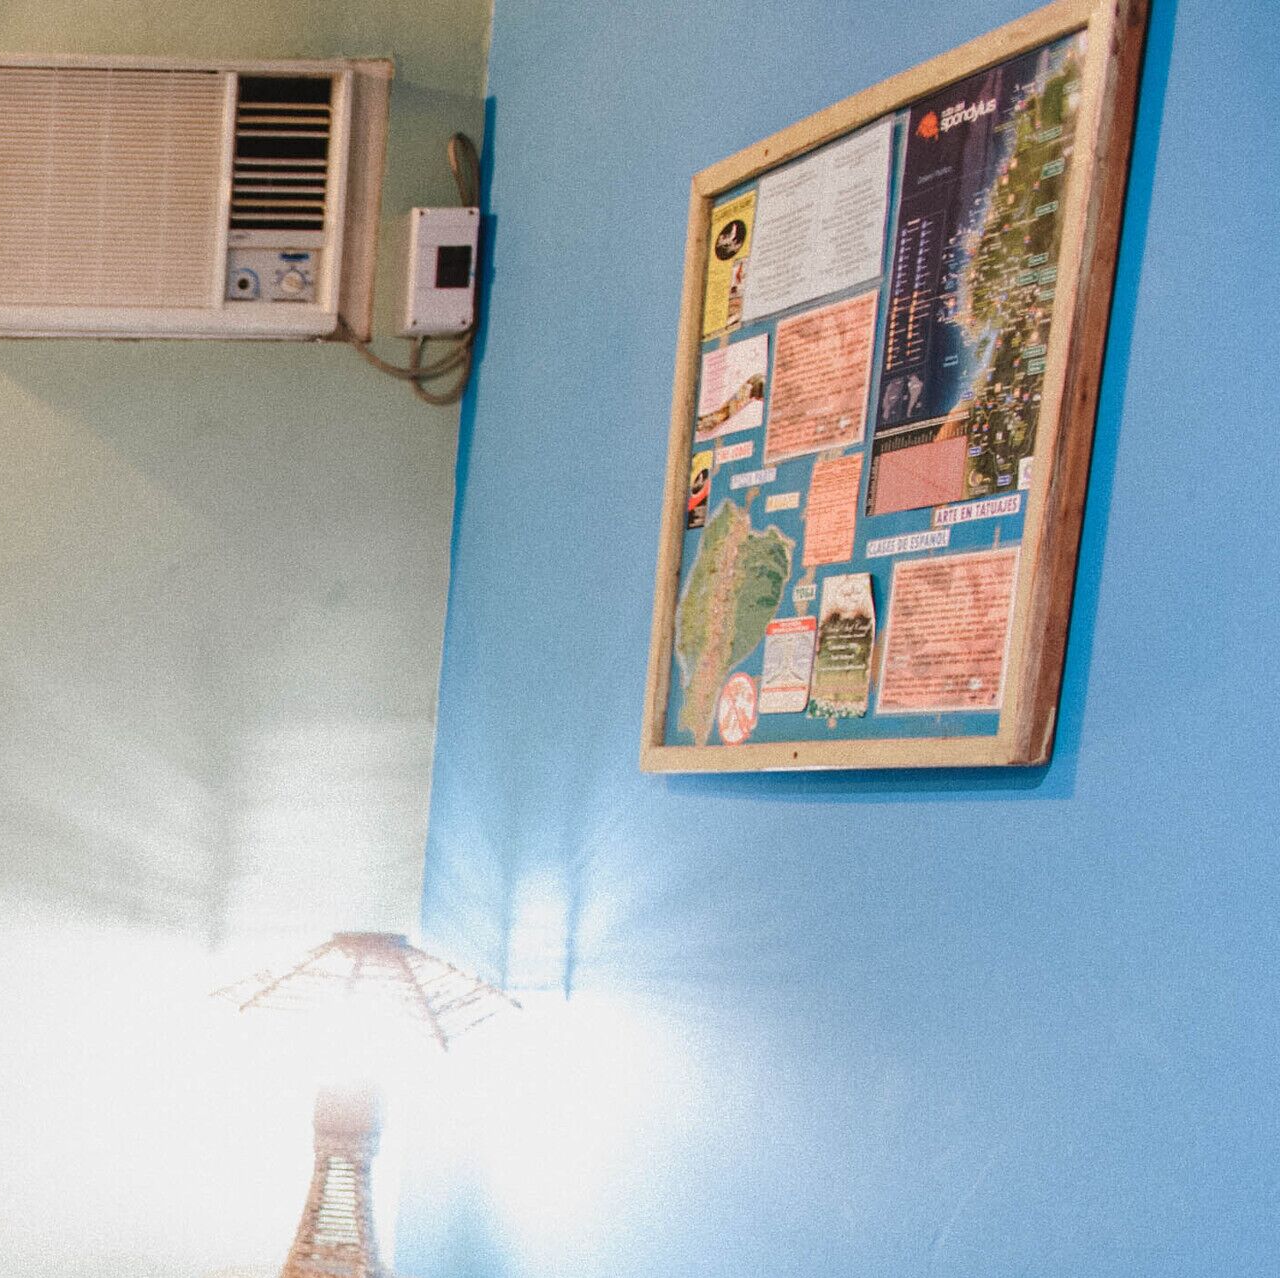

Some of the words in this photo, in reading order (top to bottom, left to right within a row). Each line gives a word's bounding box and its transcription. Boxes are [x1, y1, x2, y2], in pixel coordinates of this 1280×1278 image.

[940, 98, 996, 132] spondylus
[936, 508, 958, 524] ARTE
[960, 505, 973, 520] EN
[976, 497, 1018, 516] TATUAJES
[869, 539, 896, 555] CLASES
[897, 538, 909, 551] DE
